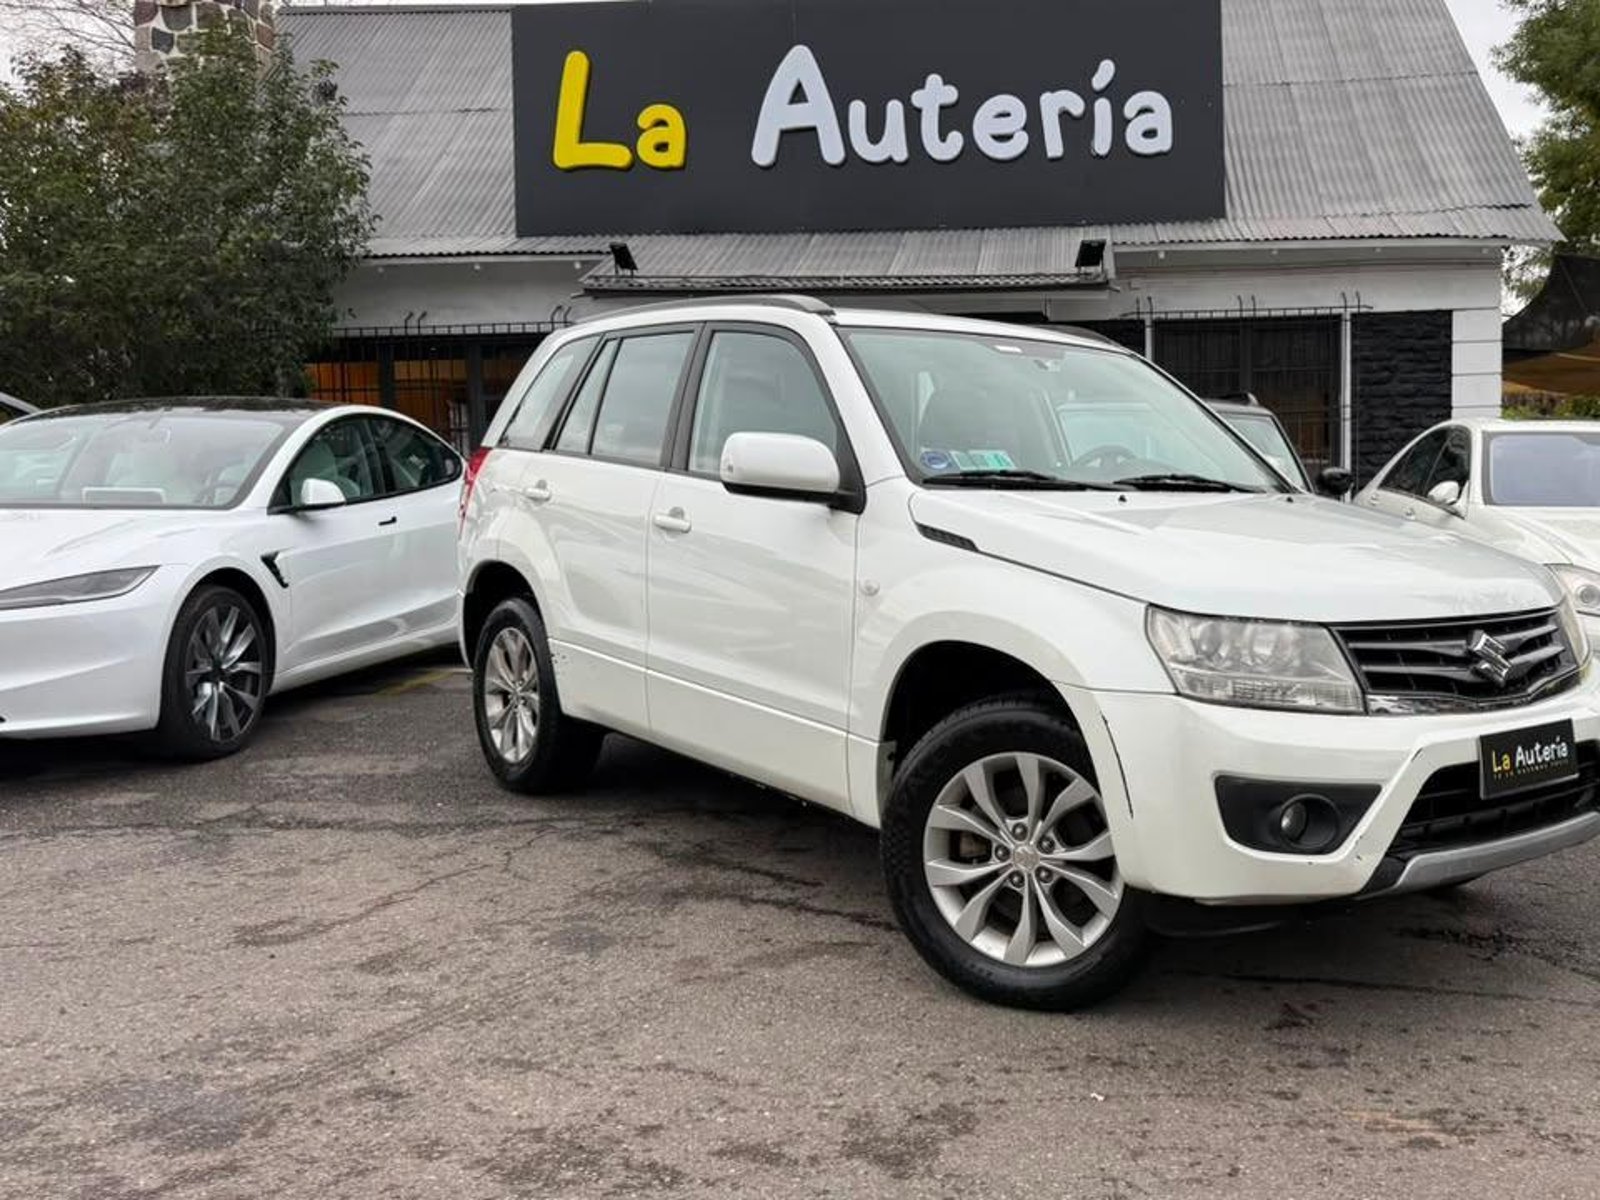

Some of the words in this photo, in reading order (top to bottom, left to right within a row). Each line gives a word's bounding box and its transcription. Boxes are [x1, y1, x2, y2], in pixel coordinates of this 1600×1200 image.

[552, 50, 688, 170] La
[750, 44, 1174, 167] Autería
[1492, 750, 1511, 773] La
[1515, 735, 1568, 768] Autería
